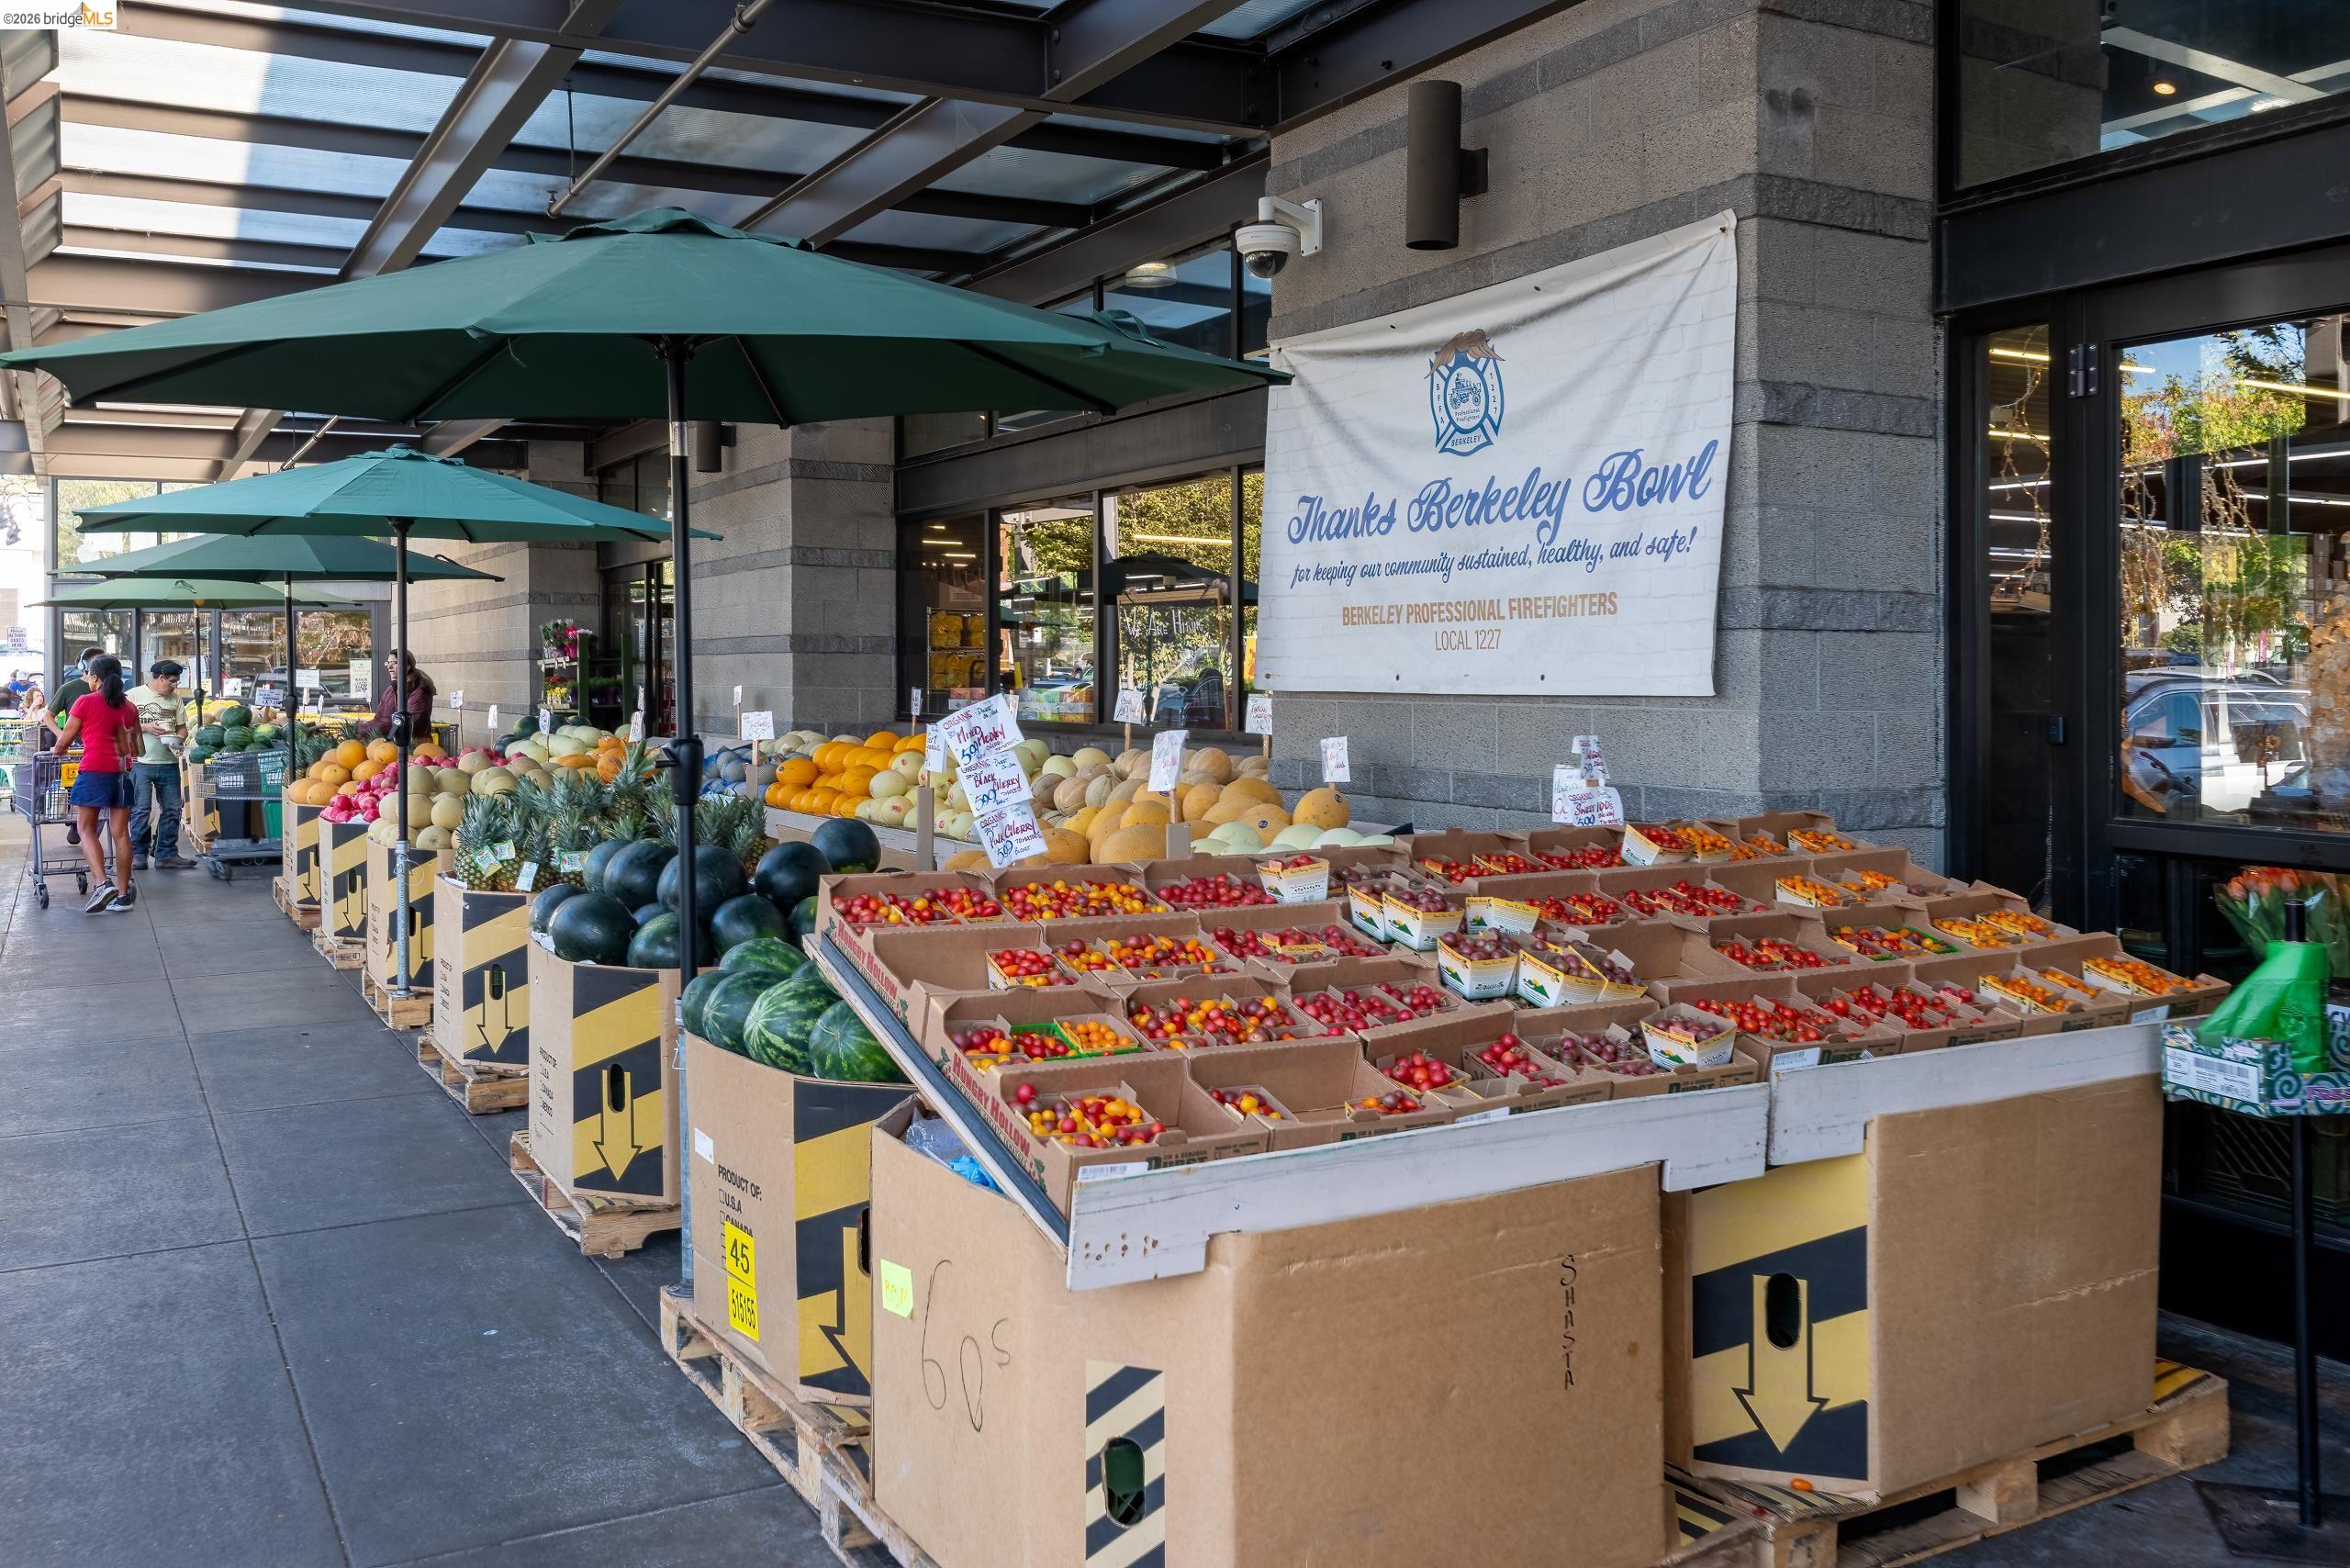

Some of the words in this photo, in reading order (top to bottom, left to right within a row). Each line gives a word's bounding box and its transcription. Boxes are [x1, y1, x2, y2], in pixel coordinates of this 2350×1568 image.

[1450, 434, 1482, 447] BERKELEY
[1287, 491, 1397, 544] Thanks
[1407, 466, 1572, 546] Berkeley
[1583, 439, 1719, 513] Bowl
[1290, 564, 1311, 589] for
[1313, 560, 1358, 587] keeping
[1360, 561, 1382, 578] our
[1384, 551, 1455, 584] community
[1457, 543, 1532, 571] sustained,
[1537, 538, 1605, 573] healthy,
[1609, 532, 1644, 559] and
[1645, 526, 1698, 563] safe!
[1342, 604, 1404, 626] BERKELEY
[1406, 599, 1505, 624] PROFESSIONAL
[1508, 591, 1618, 620] FIREFIGHTERS
[1435, 630, 1472, 651] LOCAL
[1474, 629, 1502, 650] 1227
[992, 773, 1022, 792] CHERRY
[1004, 818, 1036, 839] CHERRY
[837, 919, 867, 965] HUNGRY
[867, 951, 898, 1000] HOLLOW
[953, 1051, 990, 1110] HUNGRY
[990, 1094, 1031, 1159] HOLLOW
[718, 1163, 749, 1194] PRODUCT
[750, 1182, 763, 1203] OF:
[724, 1192, 743, 1215] U.S.A
[730, 1238, 750, 1275] 45
[731, 1288, 755, 1330] 515155
[1560, 1254, 1577, 1391] SHASTA
